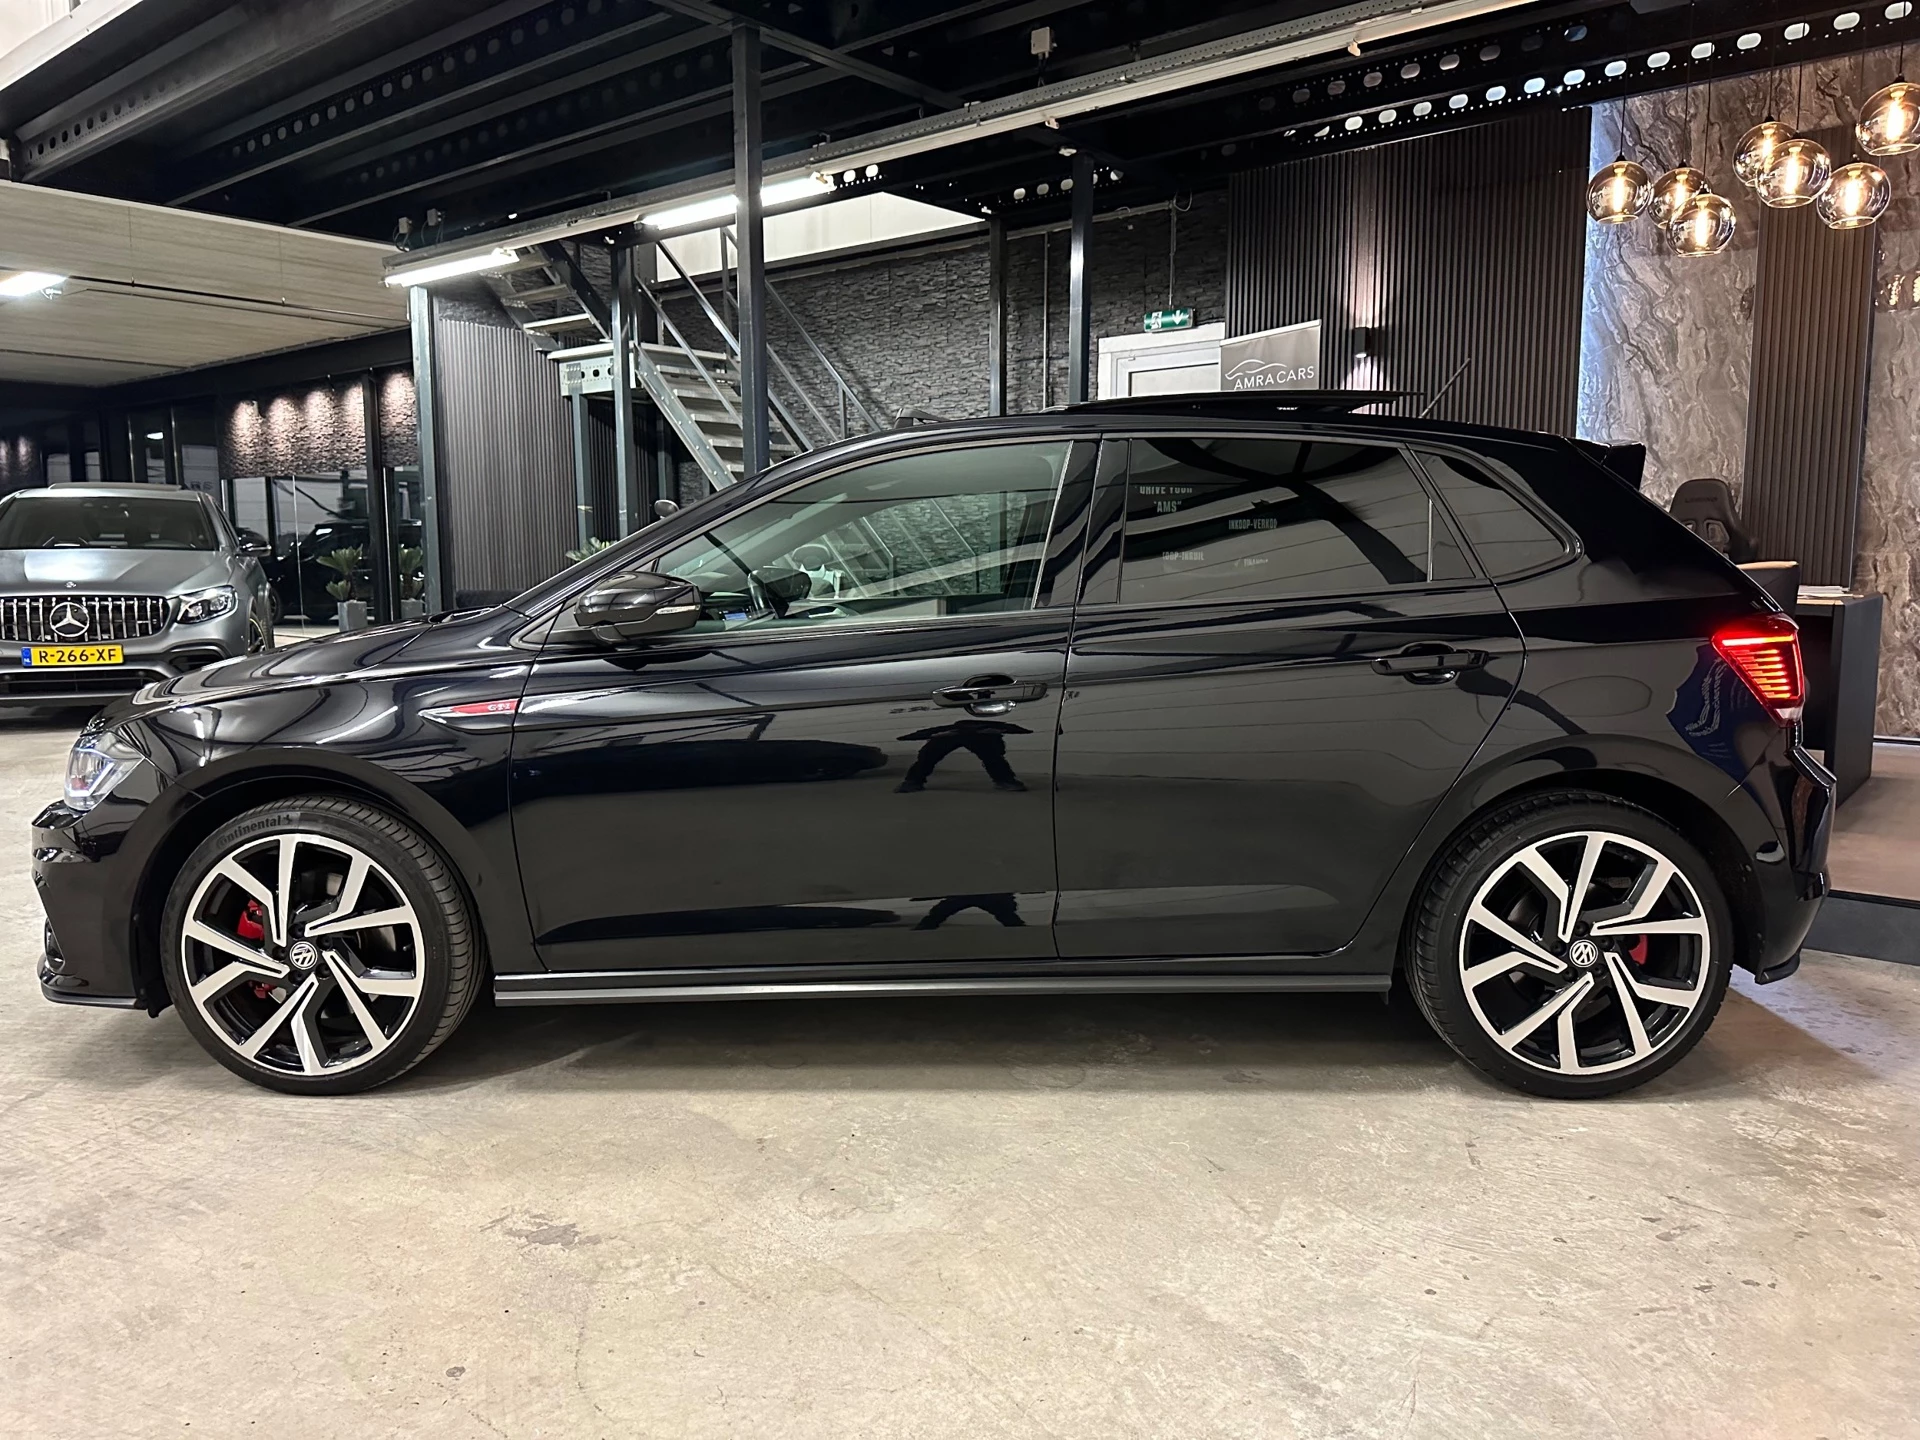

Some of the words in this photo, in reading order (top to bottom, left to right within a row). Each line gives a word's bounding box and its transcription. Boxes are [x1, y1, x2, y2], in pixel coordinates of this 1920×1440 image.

[1234, 374, 1274, 390] AMRA
[1276, 365, 1315, 383] CARS
[39, 648, 116, 663] R-266-XF
[487, 702, 511, 712] GTI
[216, 814, 281, 849] Continental
